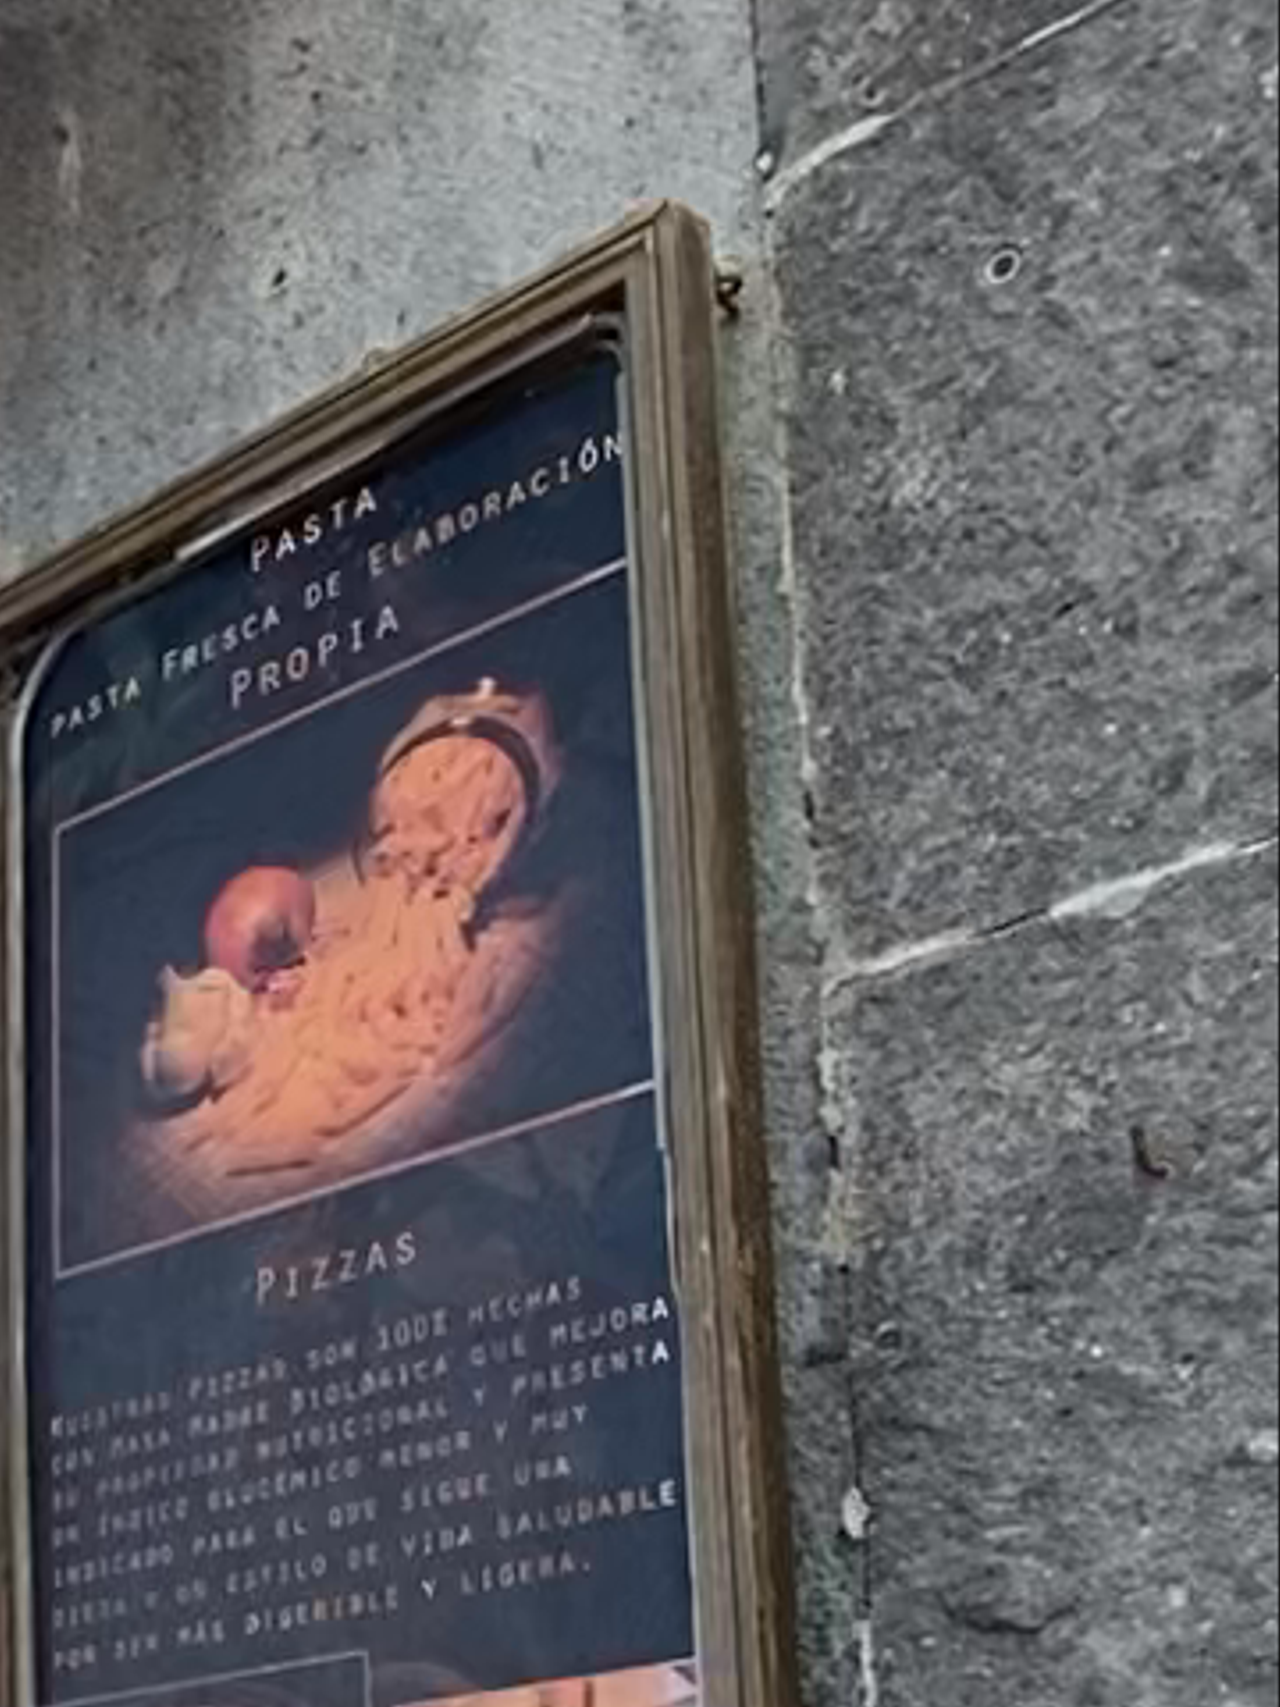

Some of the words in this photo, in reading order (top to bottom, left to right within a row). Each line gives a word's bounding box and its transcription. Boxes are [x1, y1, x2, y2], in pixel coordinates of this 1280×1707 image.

[249, 486, 378, 572] PASTA
[49, 675, 142, 738] PASTA
[160, 606, 282, 680] FRESCA
[303, 576, 341, 611] DE
[366, 433, 622, 577] ELABORACIÓN
[230, 604, 401, 708] PROPIA
[255, 1230, 418, 1305] PIZZAS
[468, 1276, 582, 1326] HECHAS
[549, 1295, 669, 1346] MEJORA
[512, 1338, 669, 1398] PRESENTA
[530, 1403, 588, 1436] MUY
[514, 1455, 572, 1487] UNA
[401, 1524, 474, 1559] VIDA
[496, 1479, 677, 1540] SALUDABLE
[421, 1578, 437, 1601] Y
